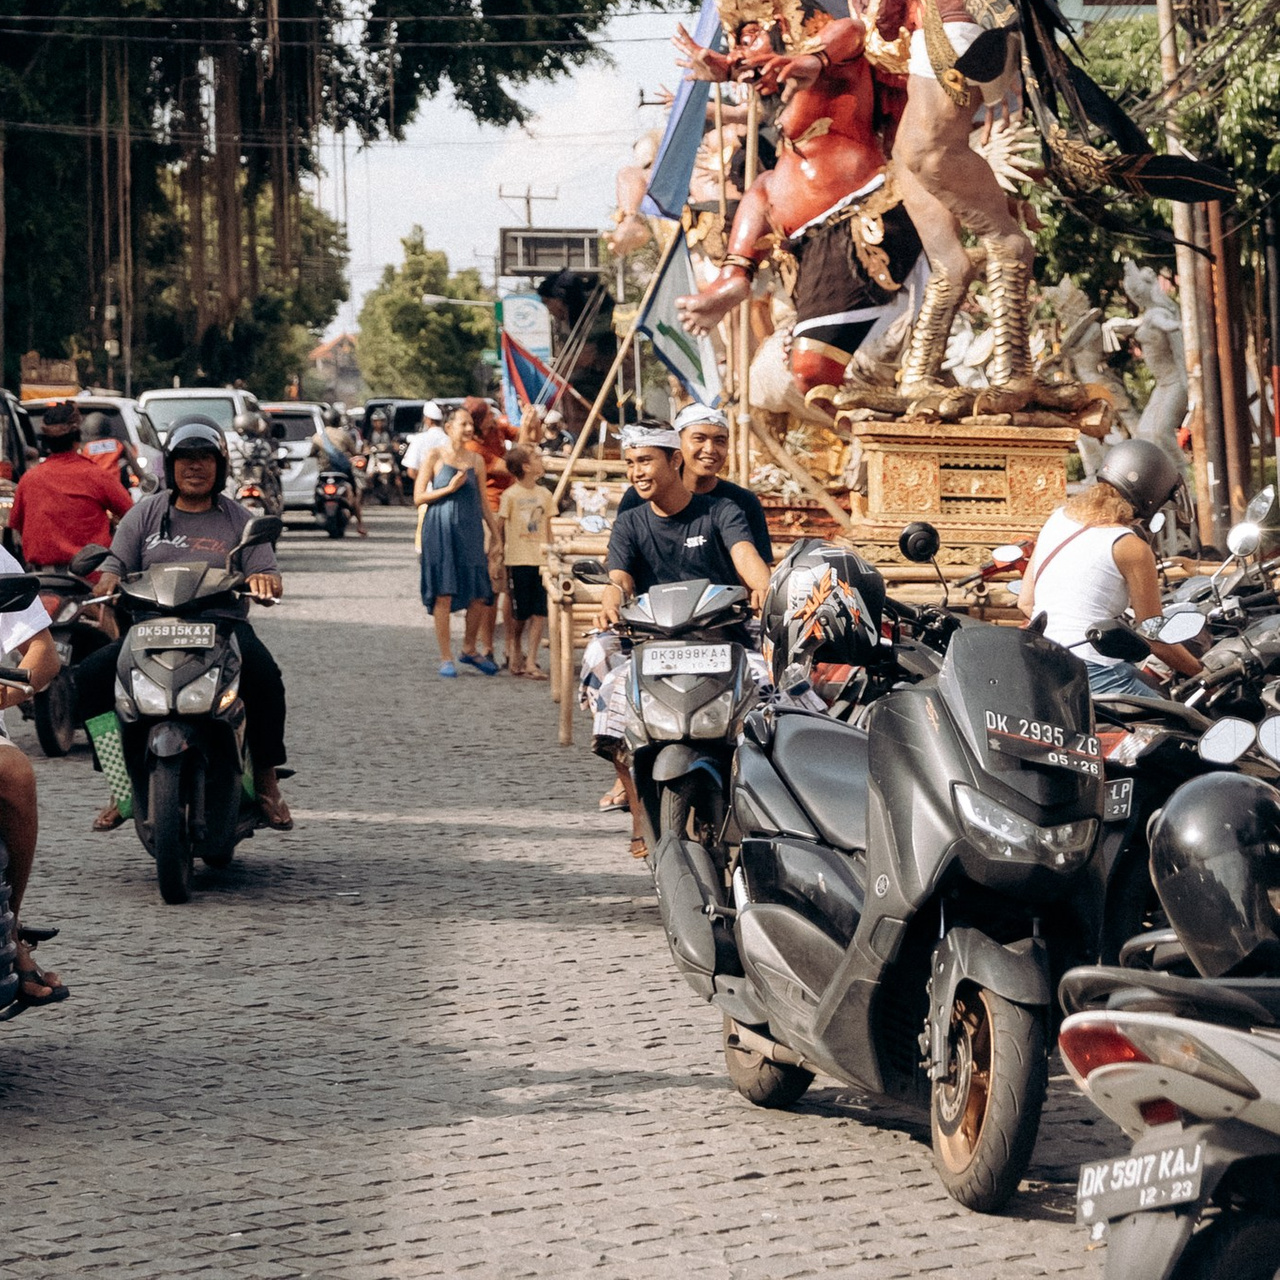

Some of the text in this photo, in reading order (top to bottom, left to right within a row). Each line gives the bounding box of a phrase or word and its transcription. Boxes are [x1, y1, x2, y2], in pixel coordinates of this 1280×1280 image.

[985, 710, 1009, 734] DK
[1019, 719, 1064, 748] 2935
[1081, 1144, 1201, 1198] DK 5917 KAJ
